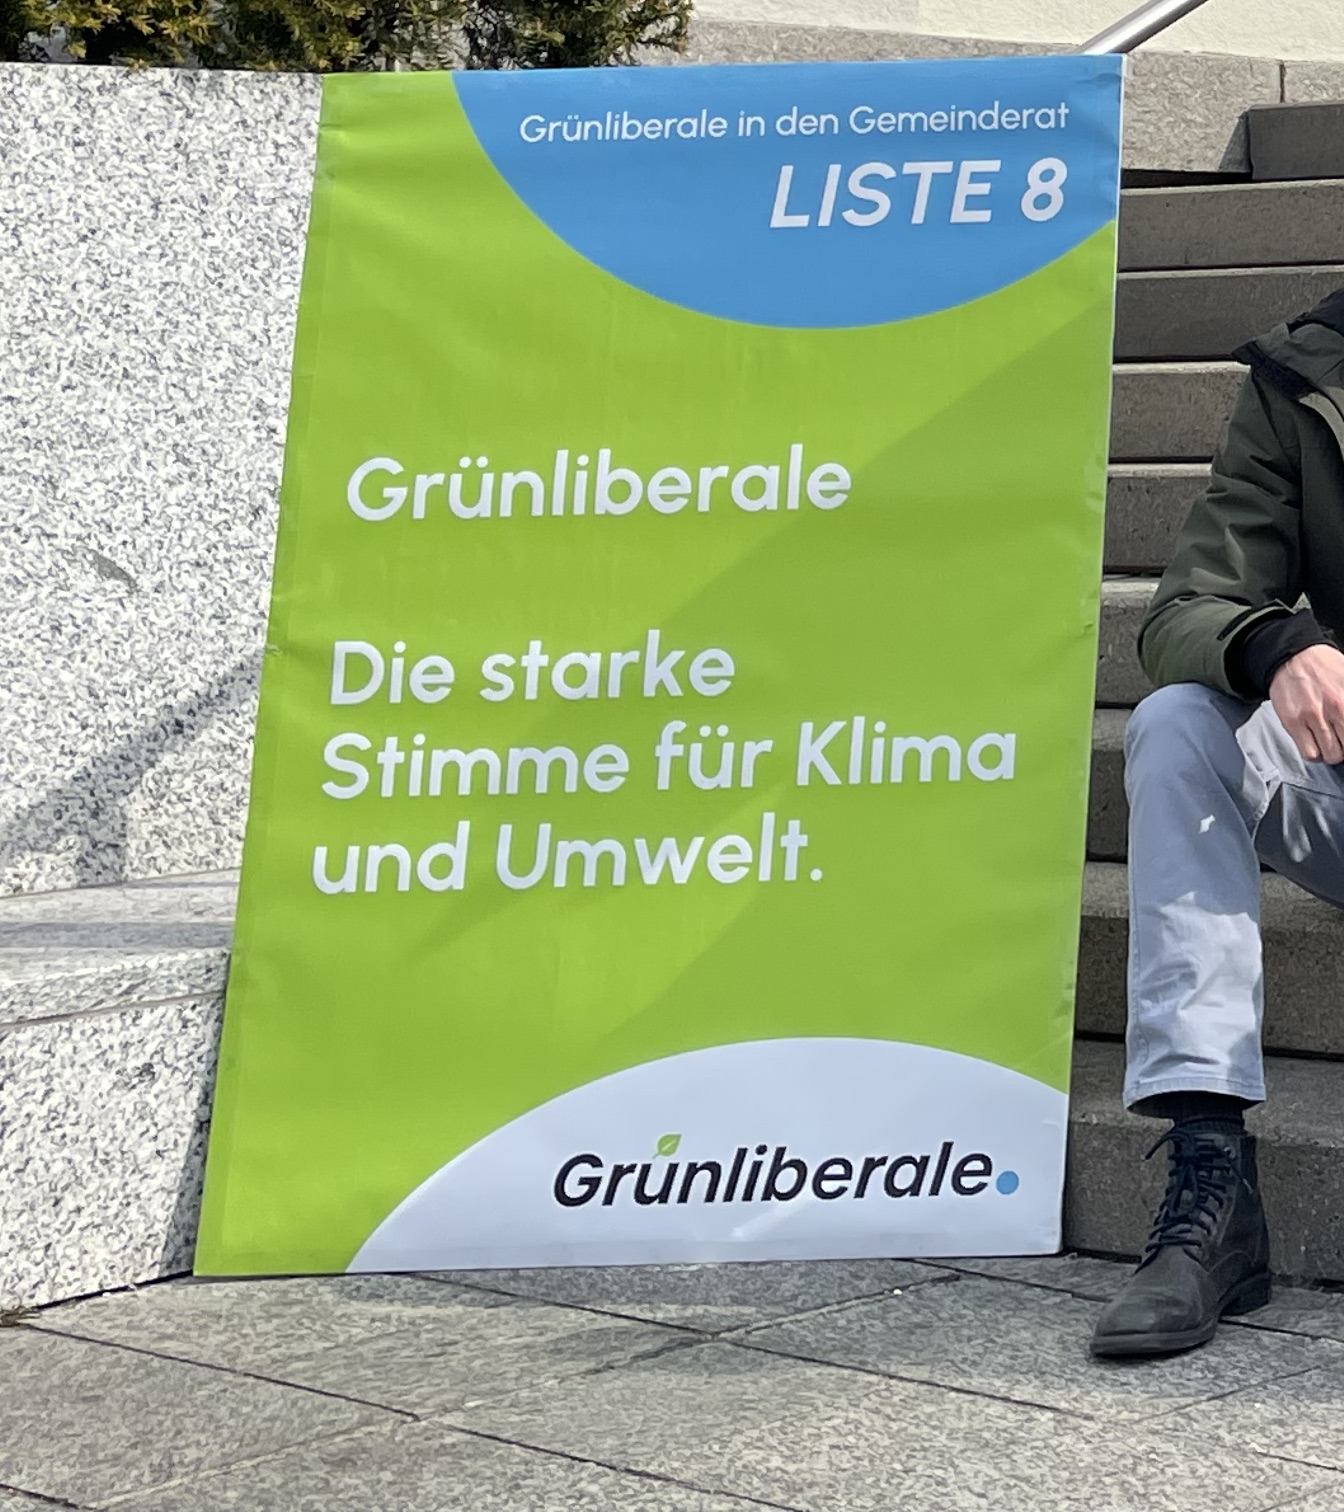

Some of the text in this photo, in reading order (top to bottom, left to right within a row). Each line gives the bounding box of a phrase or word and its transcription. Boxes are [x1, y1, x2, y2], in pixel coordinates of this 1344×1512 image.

[519, 100, 1069, 144] Grünliberale in den Gemeinderat
[769, 156, 1068, 228] LISTE 8
[347, 443, 852, 522] Grünliberale
[330, 628, 735, 705] Die starke
[320, 715, 1017, 800] Stimme für Klima
[311, 811, 824, 895] und Umwelt.
